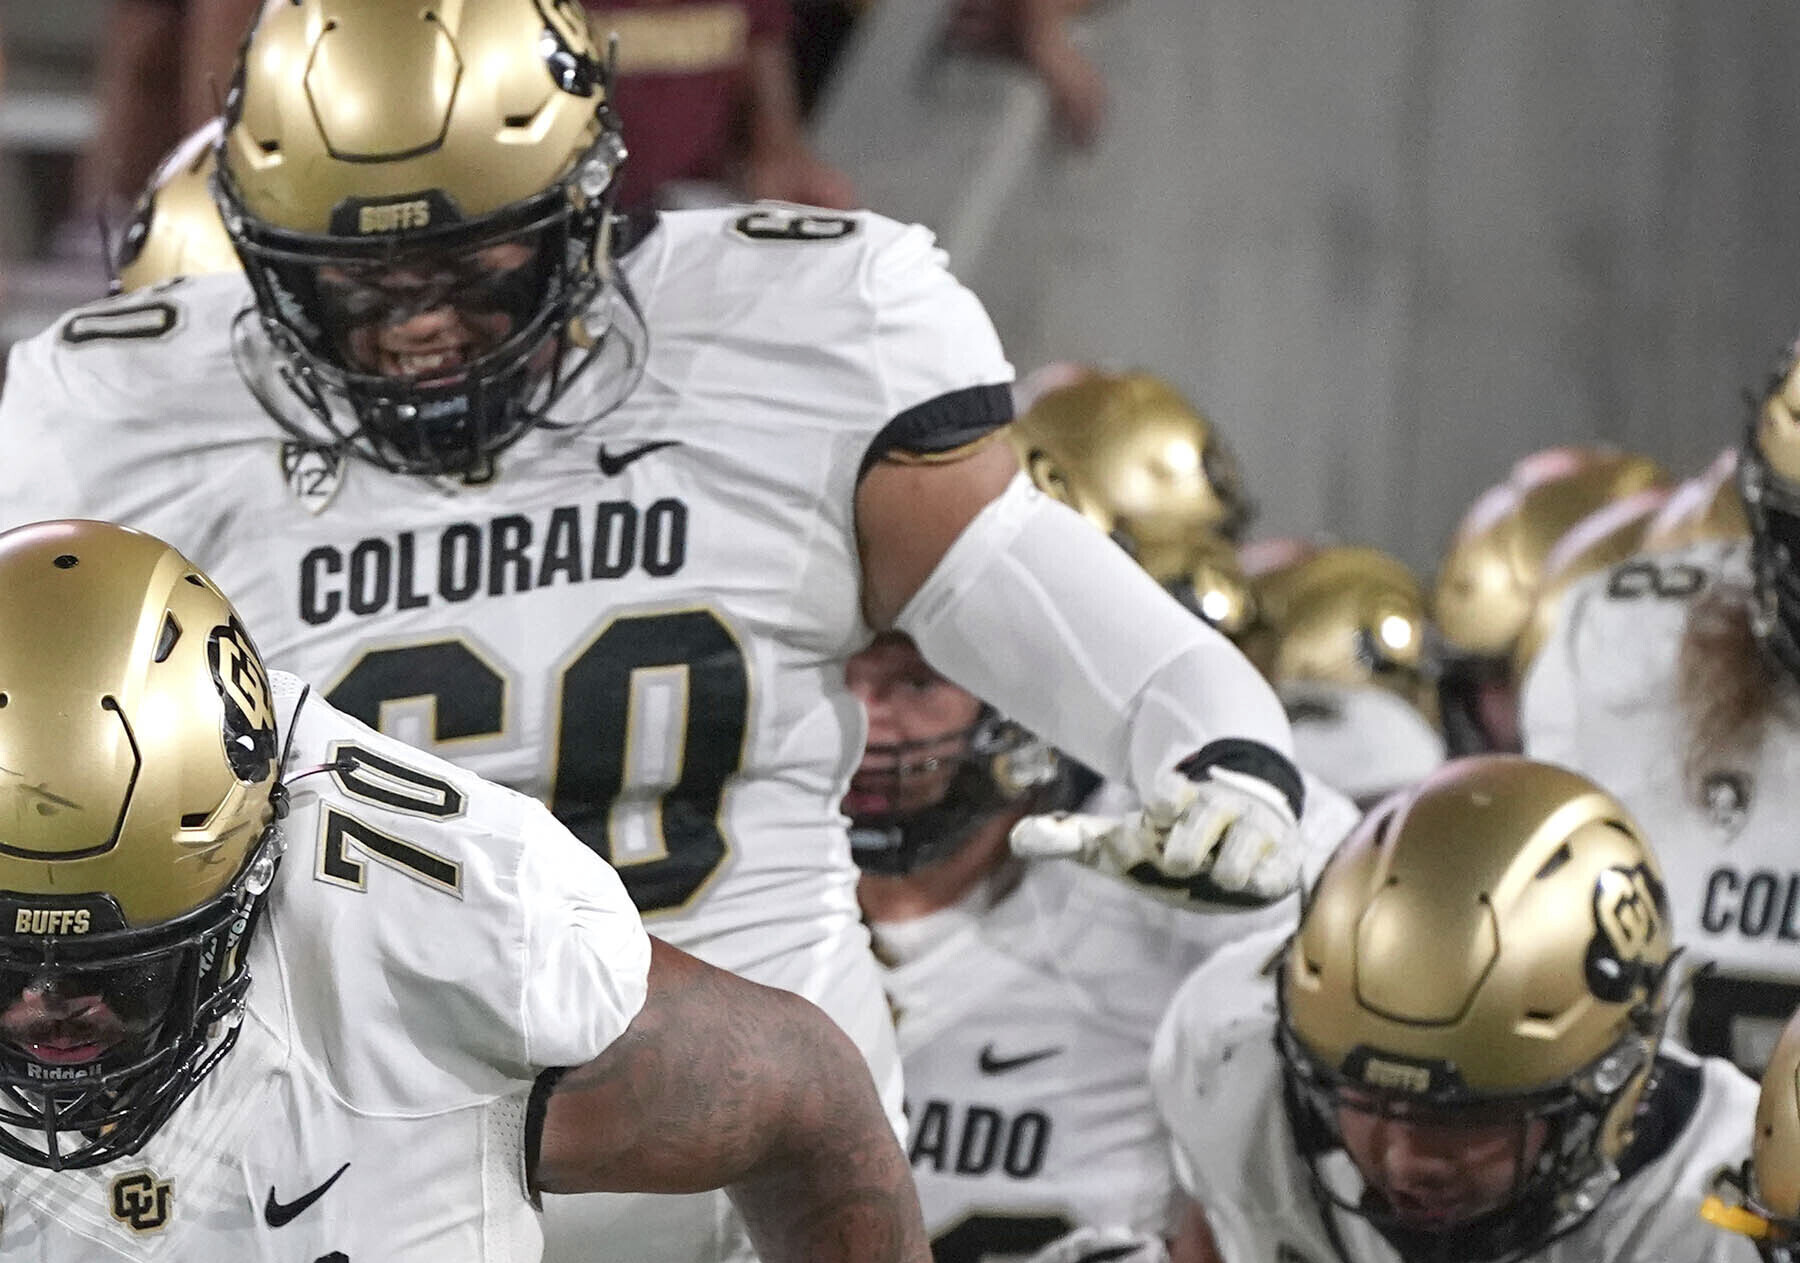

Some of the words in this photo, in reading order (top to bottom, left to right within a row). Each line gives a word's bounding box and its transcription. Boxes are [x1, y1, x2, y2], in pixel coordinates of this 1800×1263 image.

[300, 496, 688, 625] COLORADO
[314, 739, 469, 901] 70
[14, 908, 91, 935] BUFFS
[904, 1099, 1052, 1178] ADO
[112, 1172, 172, 1231] CU
